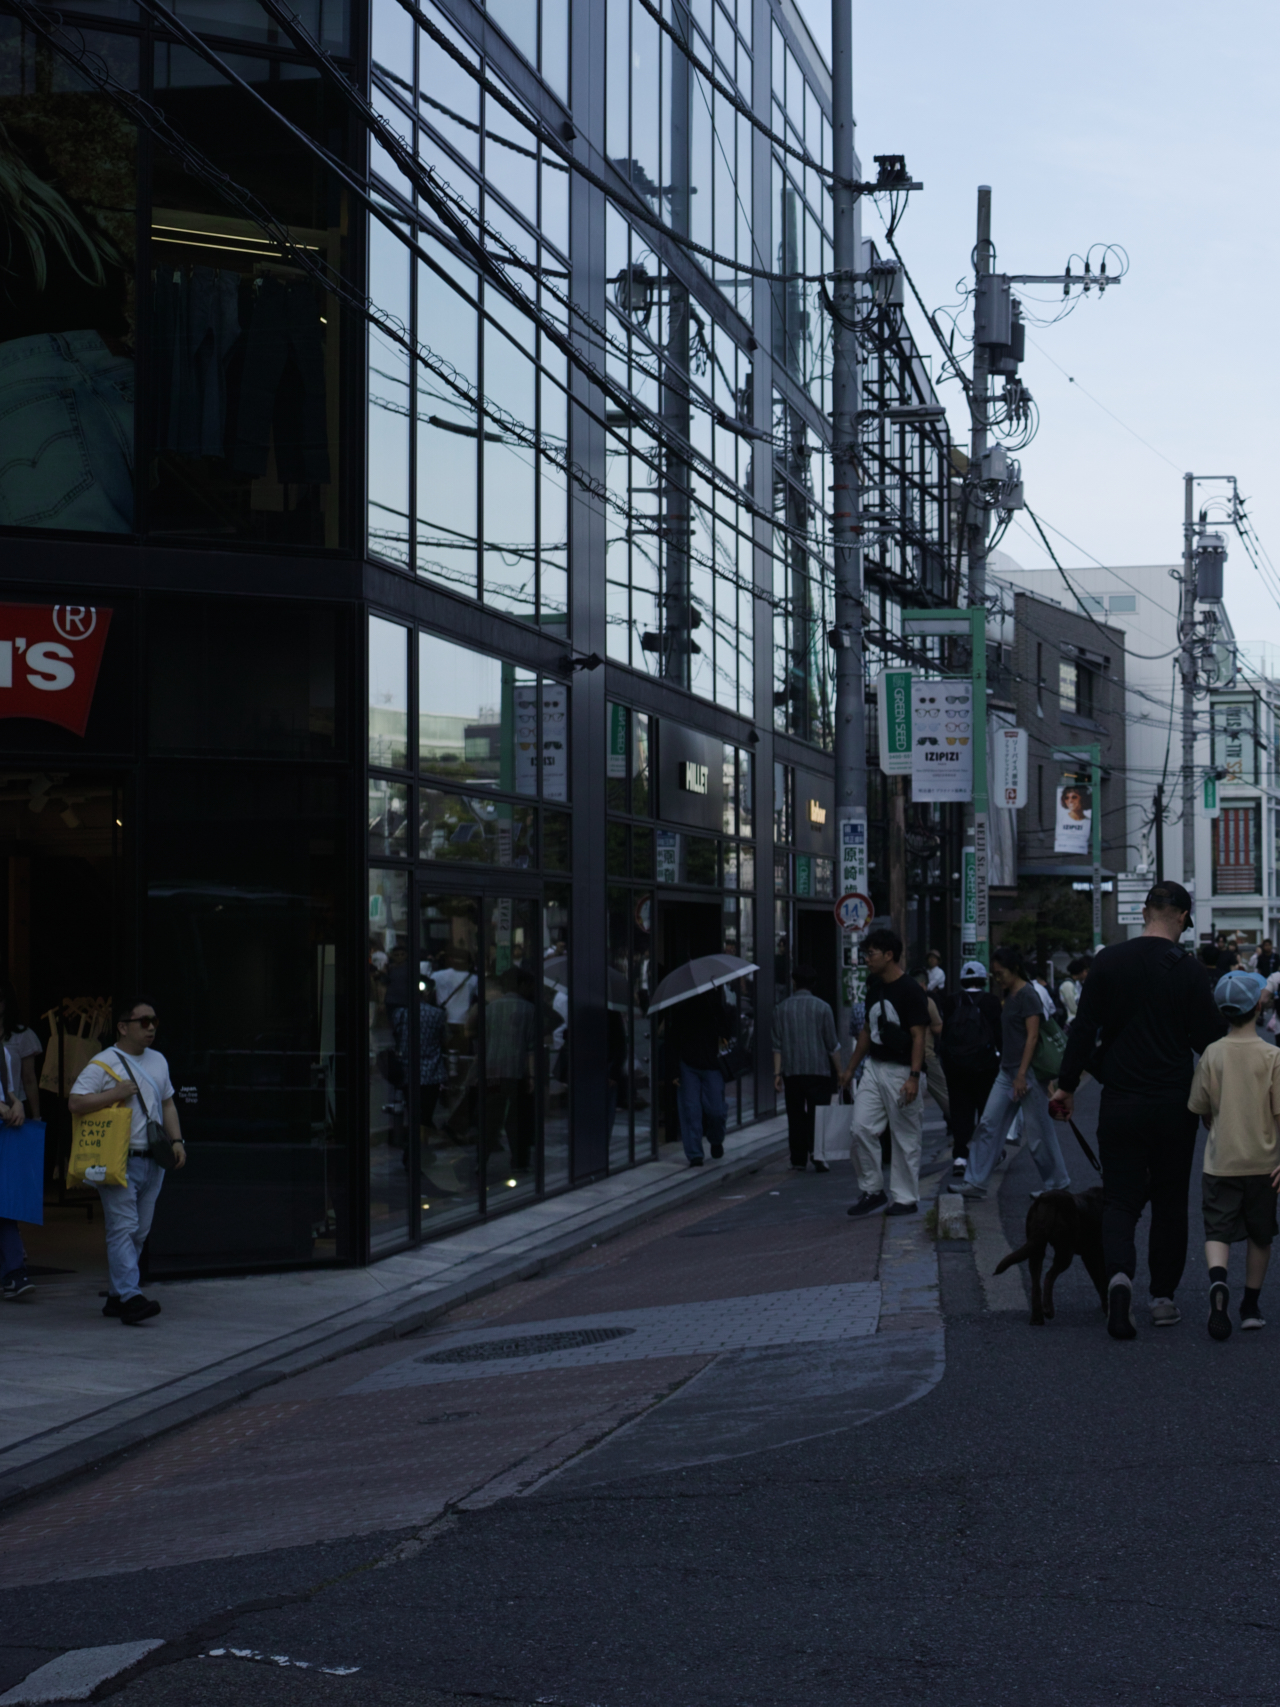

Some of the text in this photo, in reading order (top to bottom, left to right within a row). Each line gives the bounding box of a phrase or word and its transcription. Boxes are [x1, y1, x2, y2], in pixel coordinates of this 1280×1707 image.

[893, 688, 906, 723] GREEN
[894, 723, 907, 751] SEED
[925, 752, 959, 762] IZIPIZI
[1225, 743, 1243, 758] ALL
[686, 760, 709, 795] MILLET
[977, 822, 987, 927] MEIJI St. PLATANUS
[80, 1119, 113, 1129] HOUSE
[81, 1129, 106, 1138] CATS
[79, 1139, 102, 1148] CLUB
